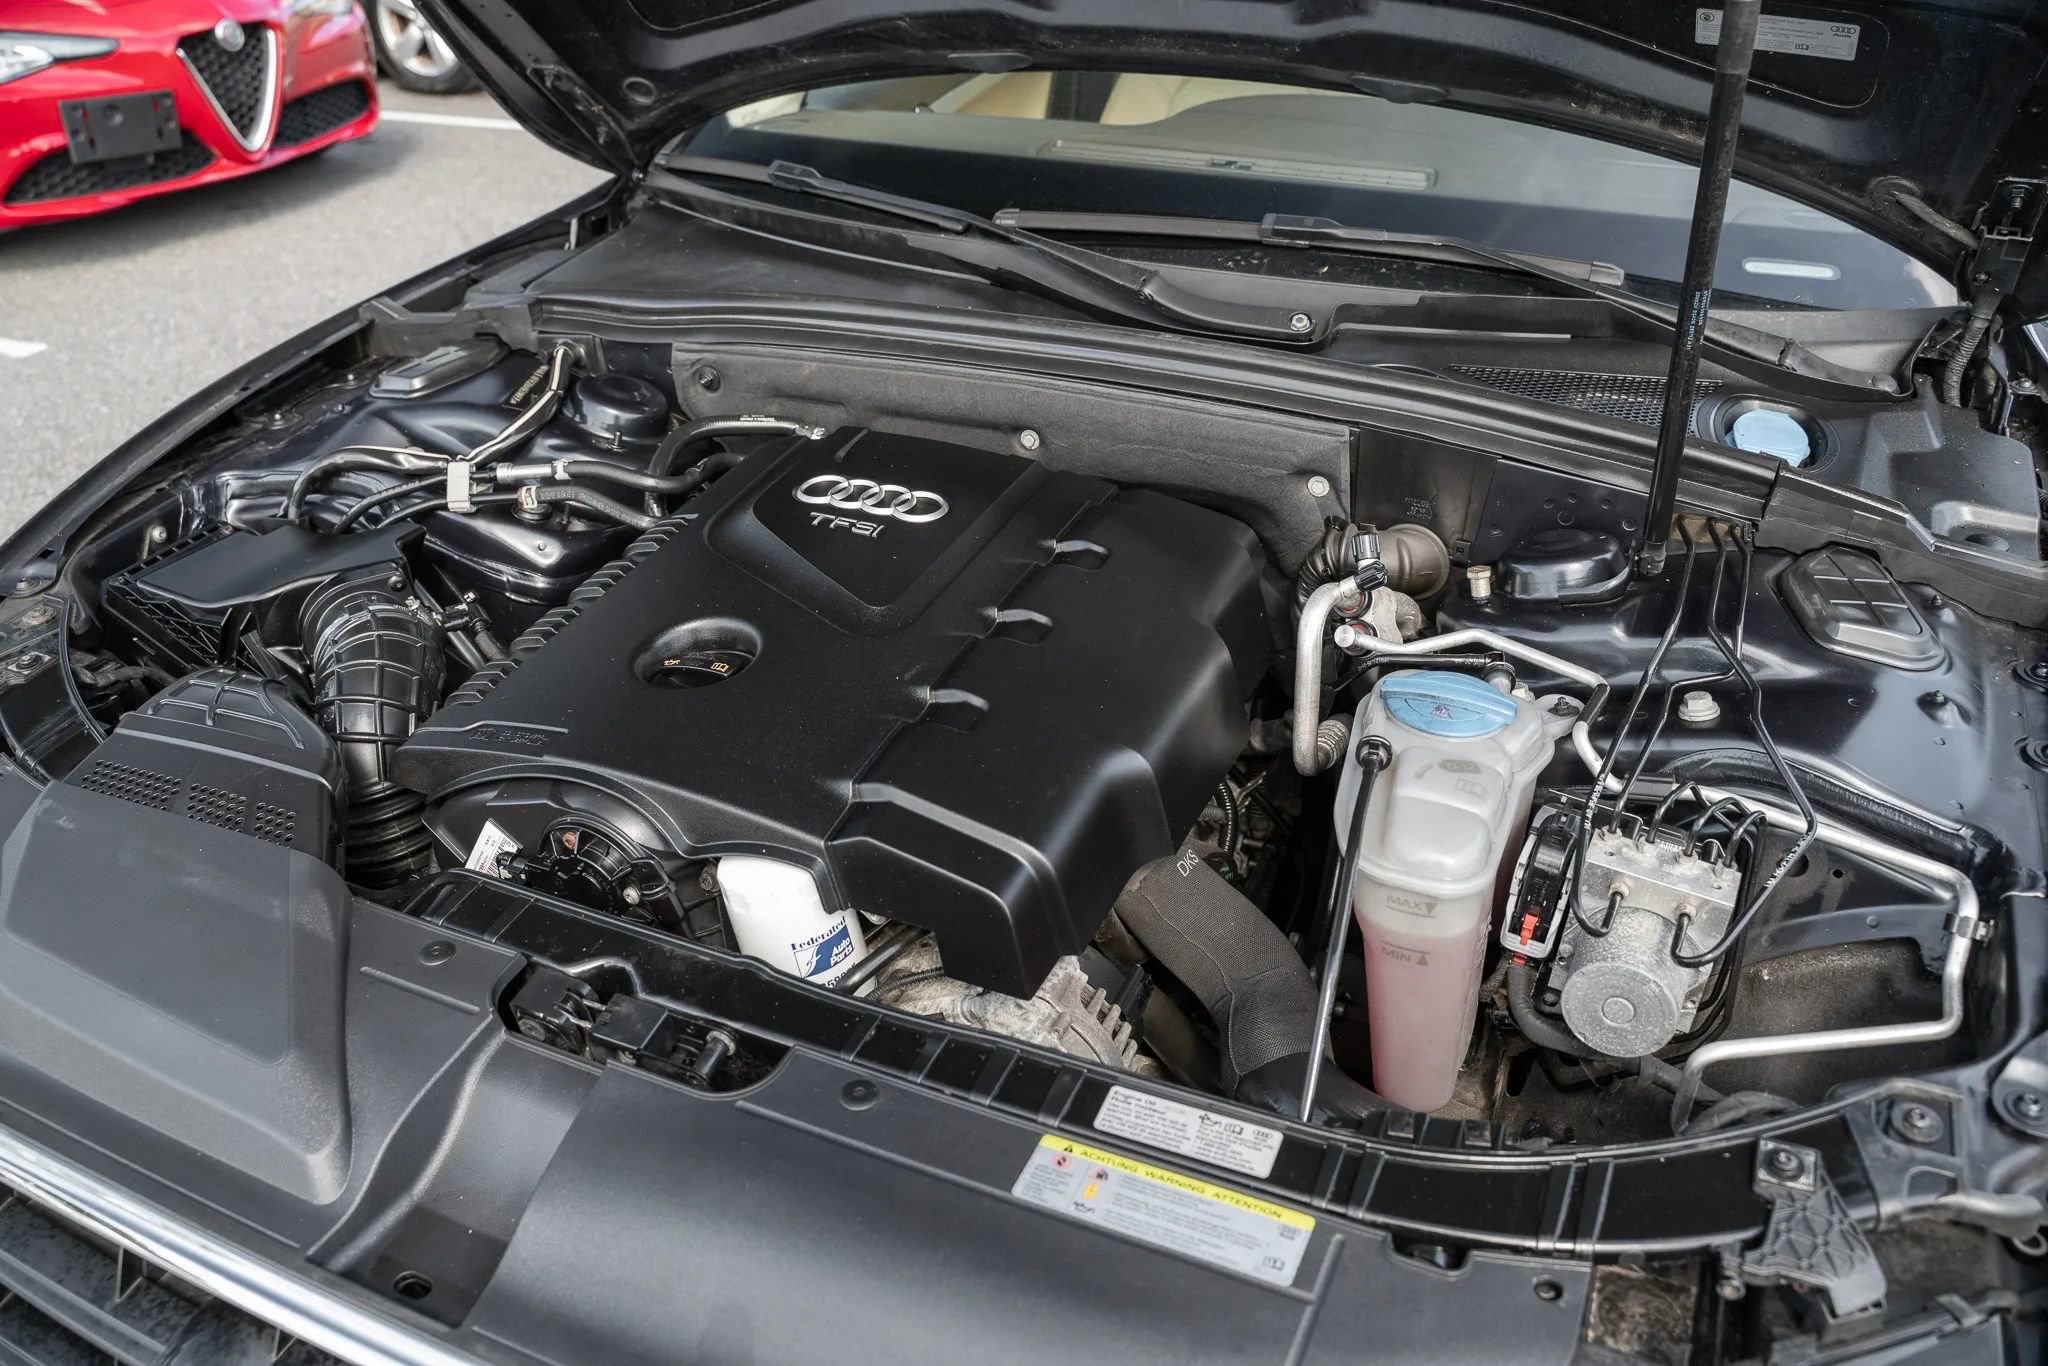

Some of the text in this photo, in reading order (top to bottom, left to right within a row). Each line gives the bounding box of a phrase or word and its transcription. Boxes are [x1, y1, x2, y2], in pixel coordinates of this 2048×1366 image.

[809, 511, 885, 538] TFSI
[1386, 894, 1423, 911] MAX
[791, 916, 846, 951] Federated
[830, 945, 853, 967] Parts
[832, 937, 851, 957] Auto
[1380, 946, 1412, 963] MIN
[1080, 1150, 1284, 1219] ACHTUNG WARNING ATTENTION
